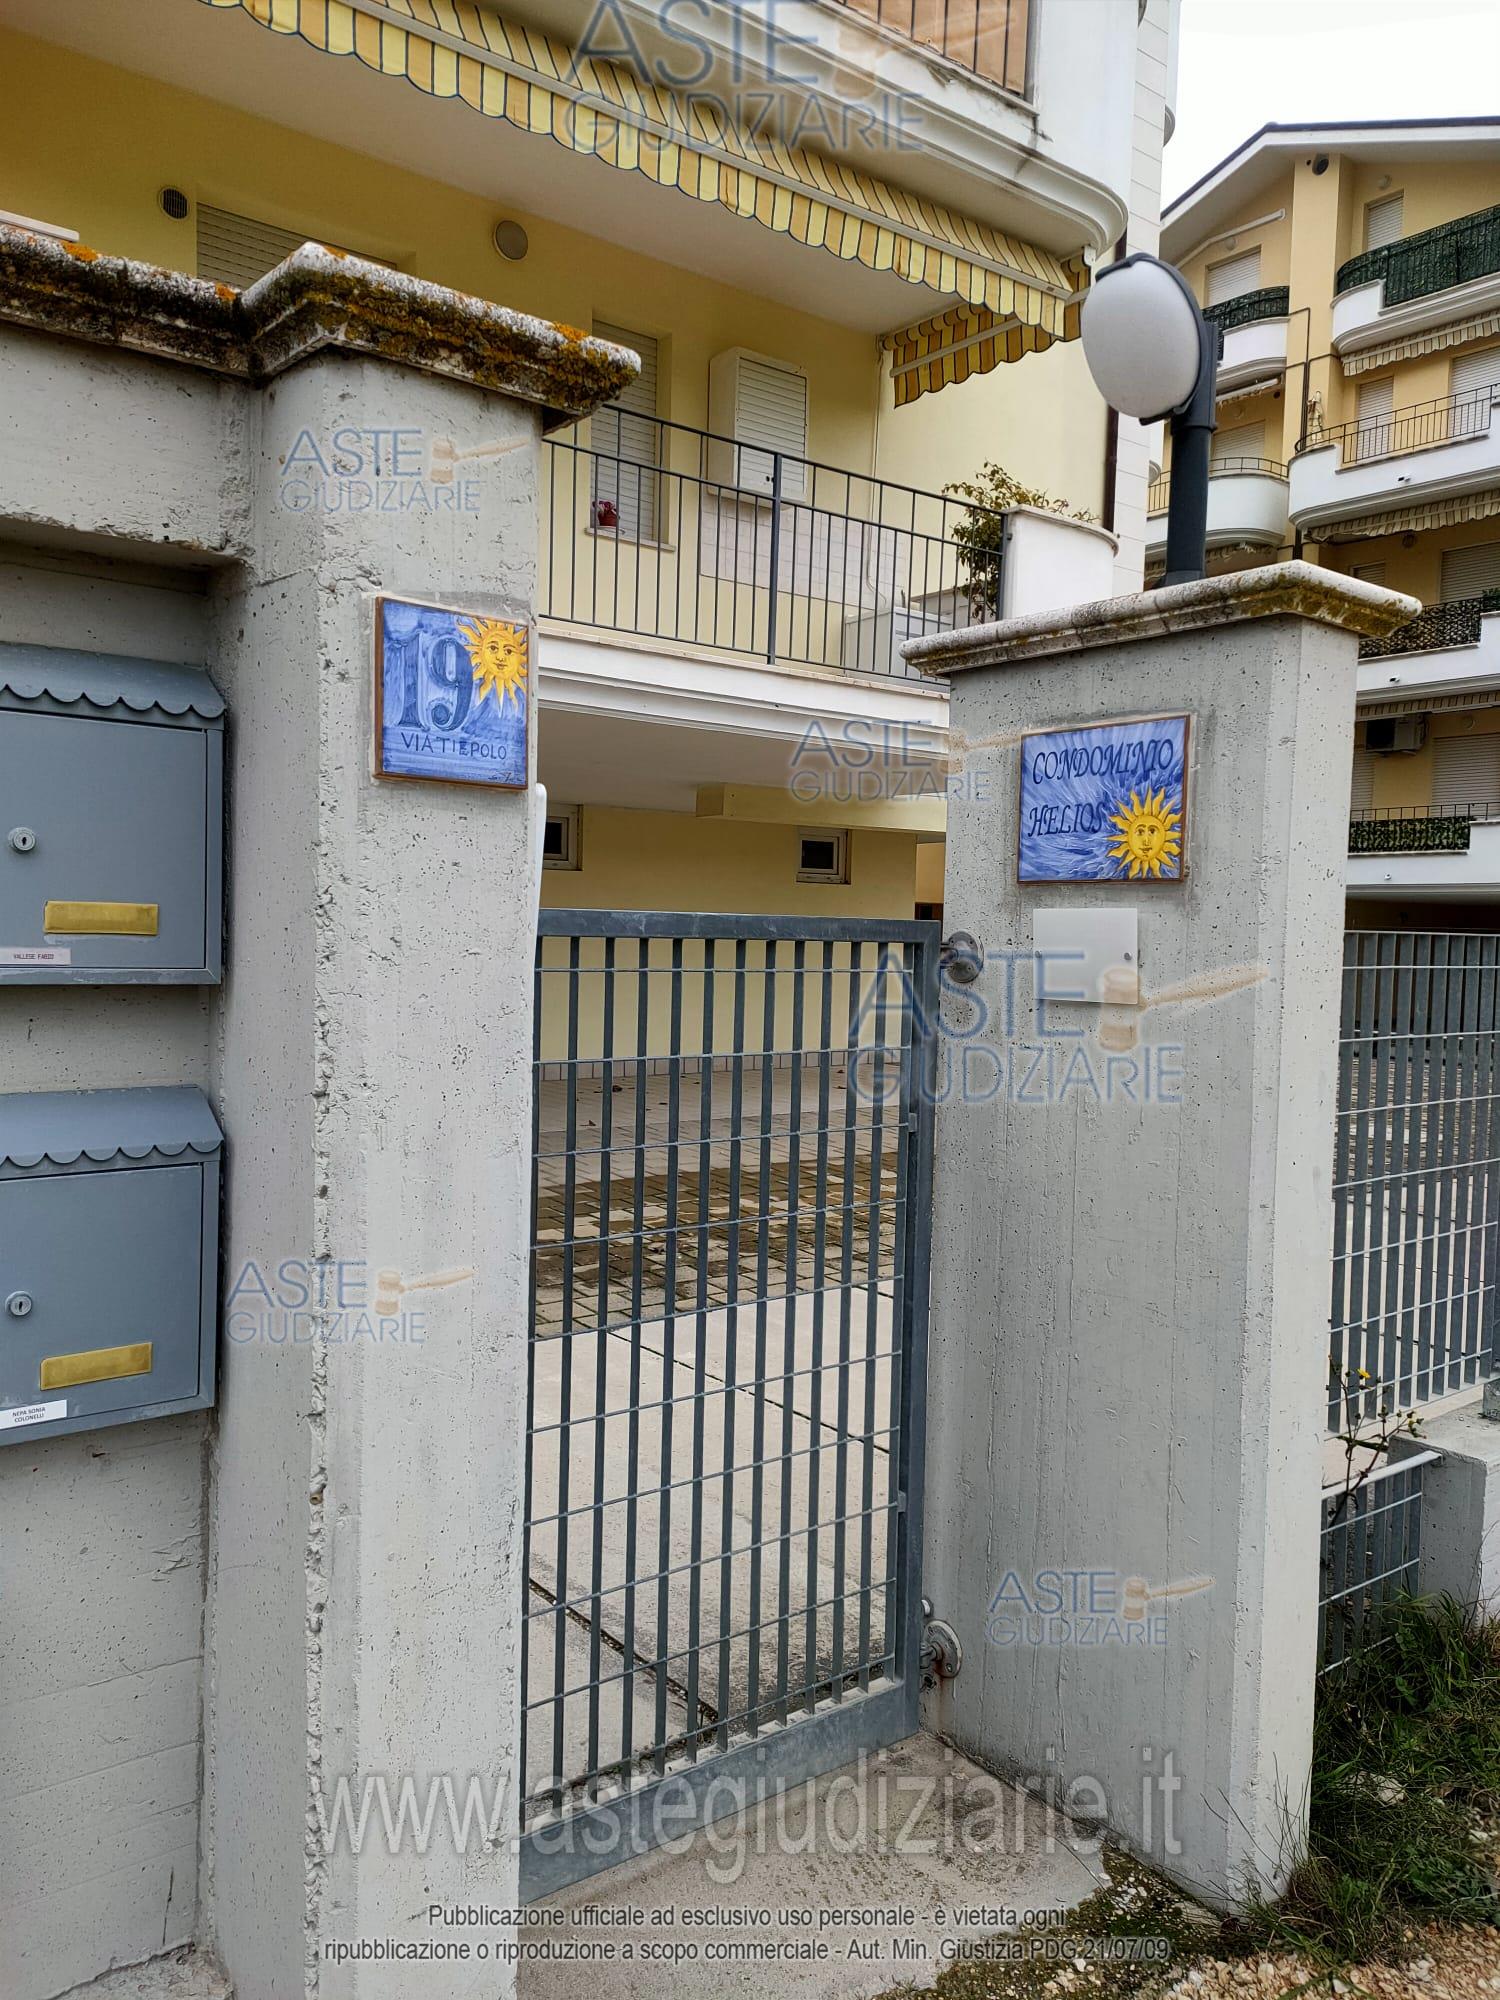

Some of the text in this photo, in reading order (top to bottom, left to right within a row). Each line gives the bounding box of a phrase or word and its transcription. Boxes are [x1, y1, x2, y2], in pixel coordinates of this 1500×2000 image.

[394, 628, 474, 732] 19
[401, 732, 507, 760] VIA TIEPOLO
[1033, 739, 1173, 785] CONDOMINIO
[1028, 802, 1105, 837] HELIOS
